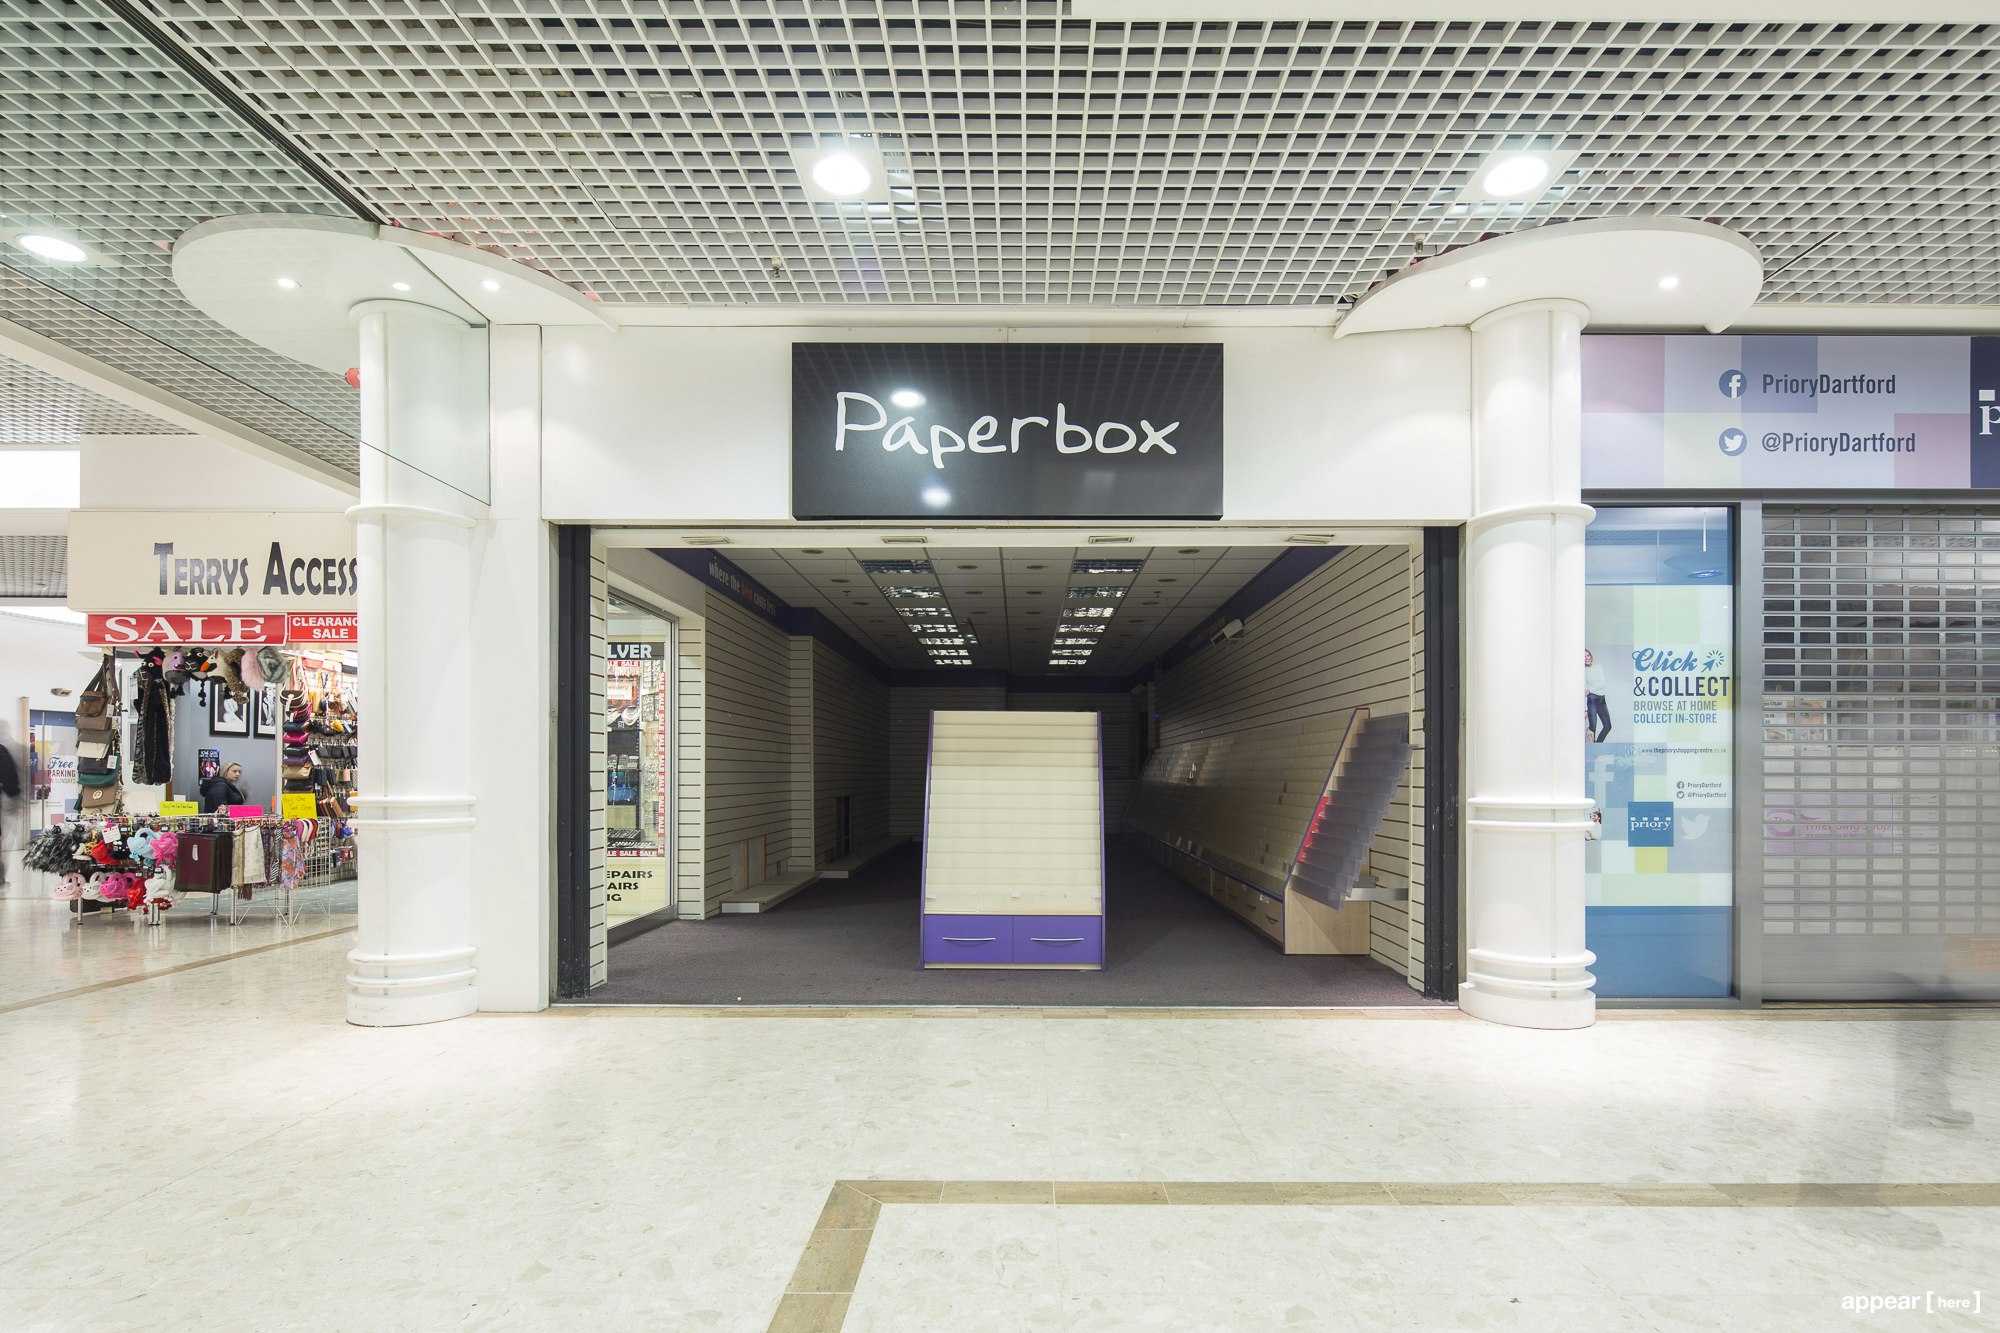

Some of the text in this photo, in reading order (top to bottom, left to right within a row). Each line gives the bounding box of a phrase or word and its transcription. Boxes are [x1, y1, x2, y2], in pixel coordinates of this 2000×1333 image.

[1762, 373, 1896, 397] PrioryDartford
[835, 391, 1180, 469] Paperbox
[1762, 432, 1916, 456] @PrioryDartford
[153, 542, 249, 596] TERRYS
[104, 616, 268, 643] SALE
[312, 628, 349, 639] SALE
[1631, 647, 1698, 672] Click
[1633, 676, 1730, 697] &COLLECT
[1633, 700, 1717, 711] BROWSE AT HOME
[1633, 713, 1717, 724] COLLECT IN-STORE
[47, 756, 74, 769] Free
[47, 769, 76, 778] PARKING
[1630, 817, 1672, 832] priory
